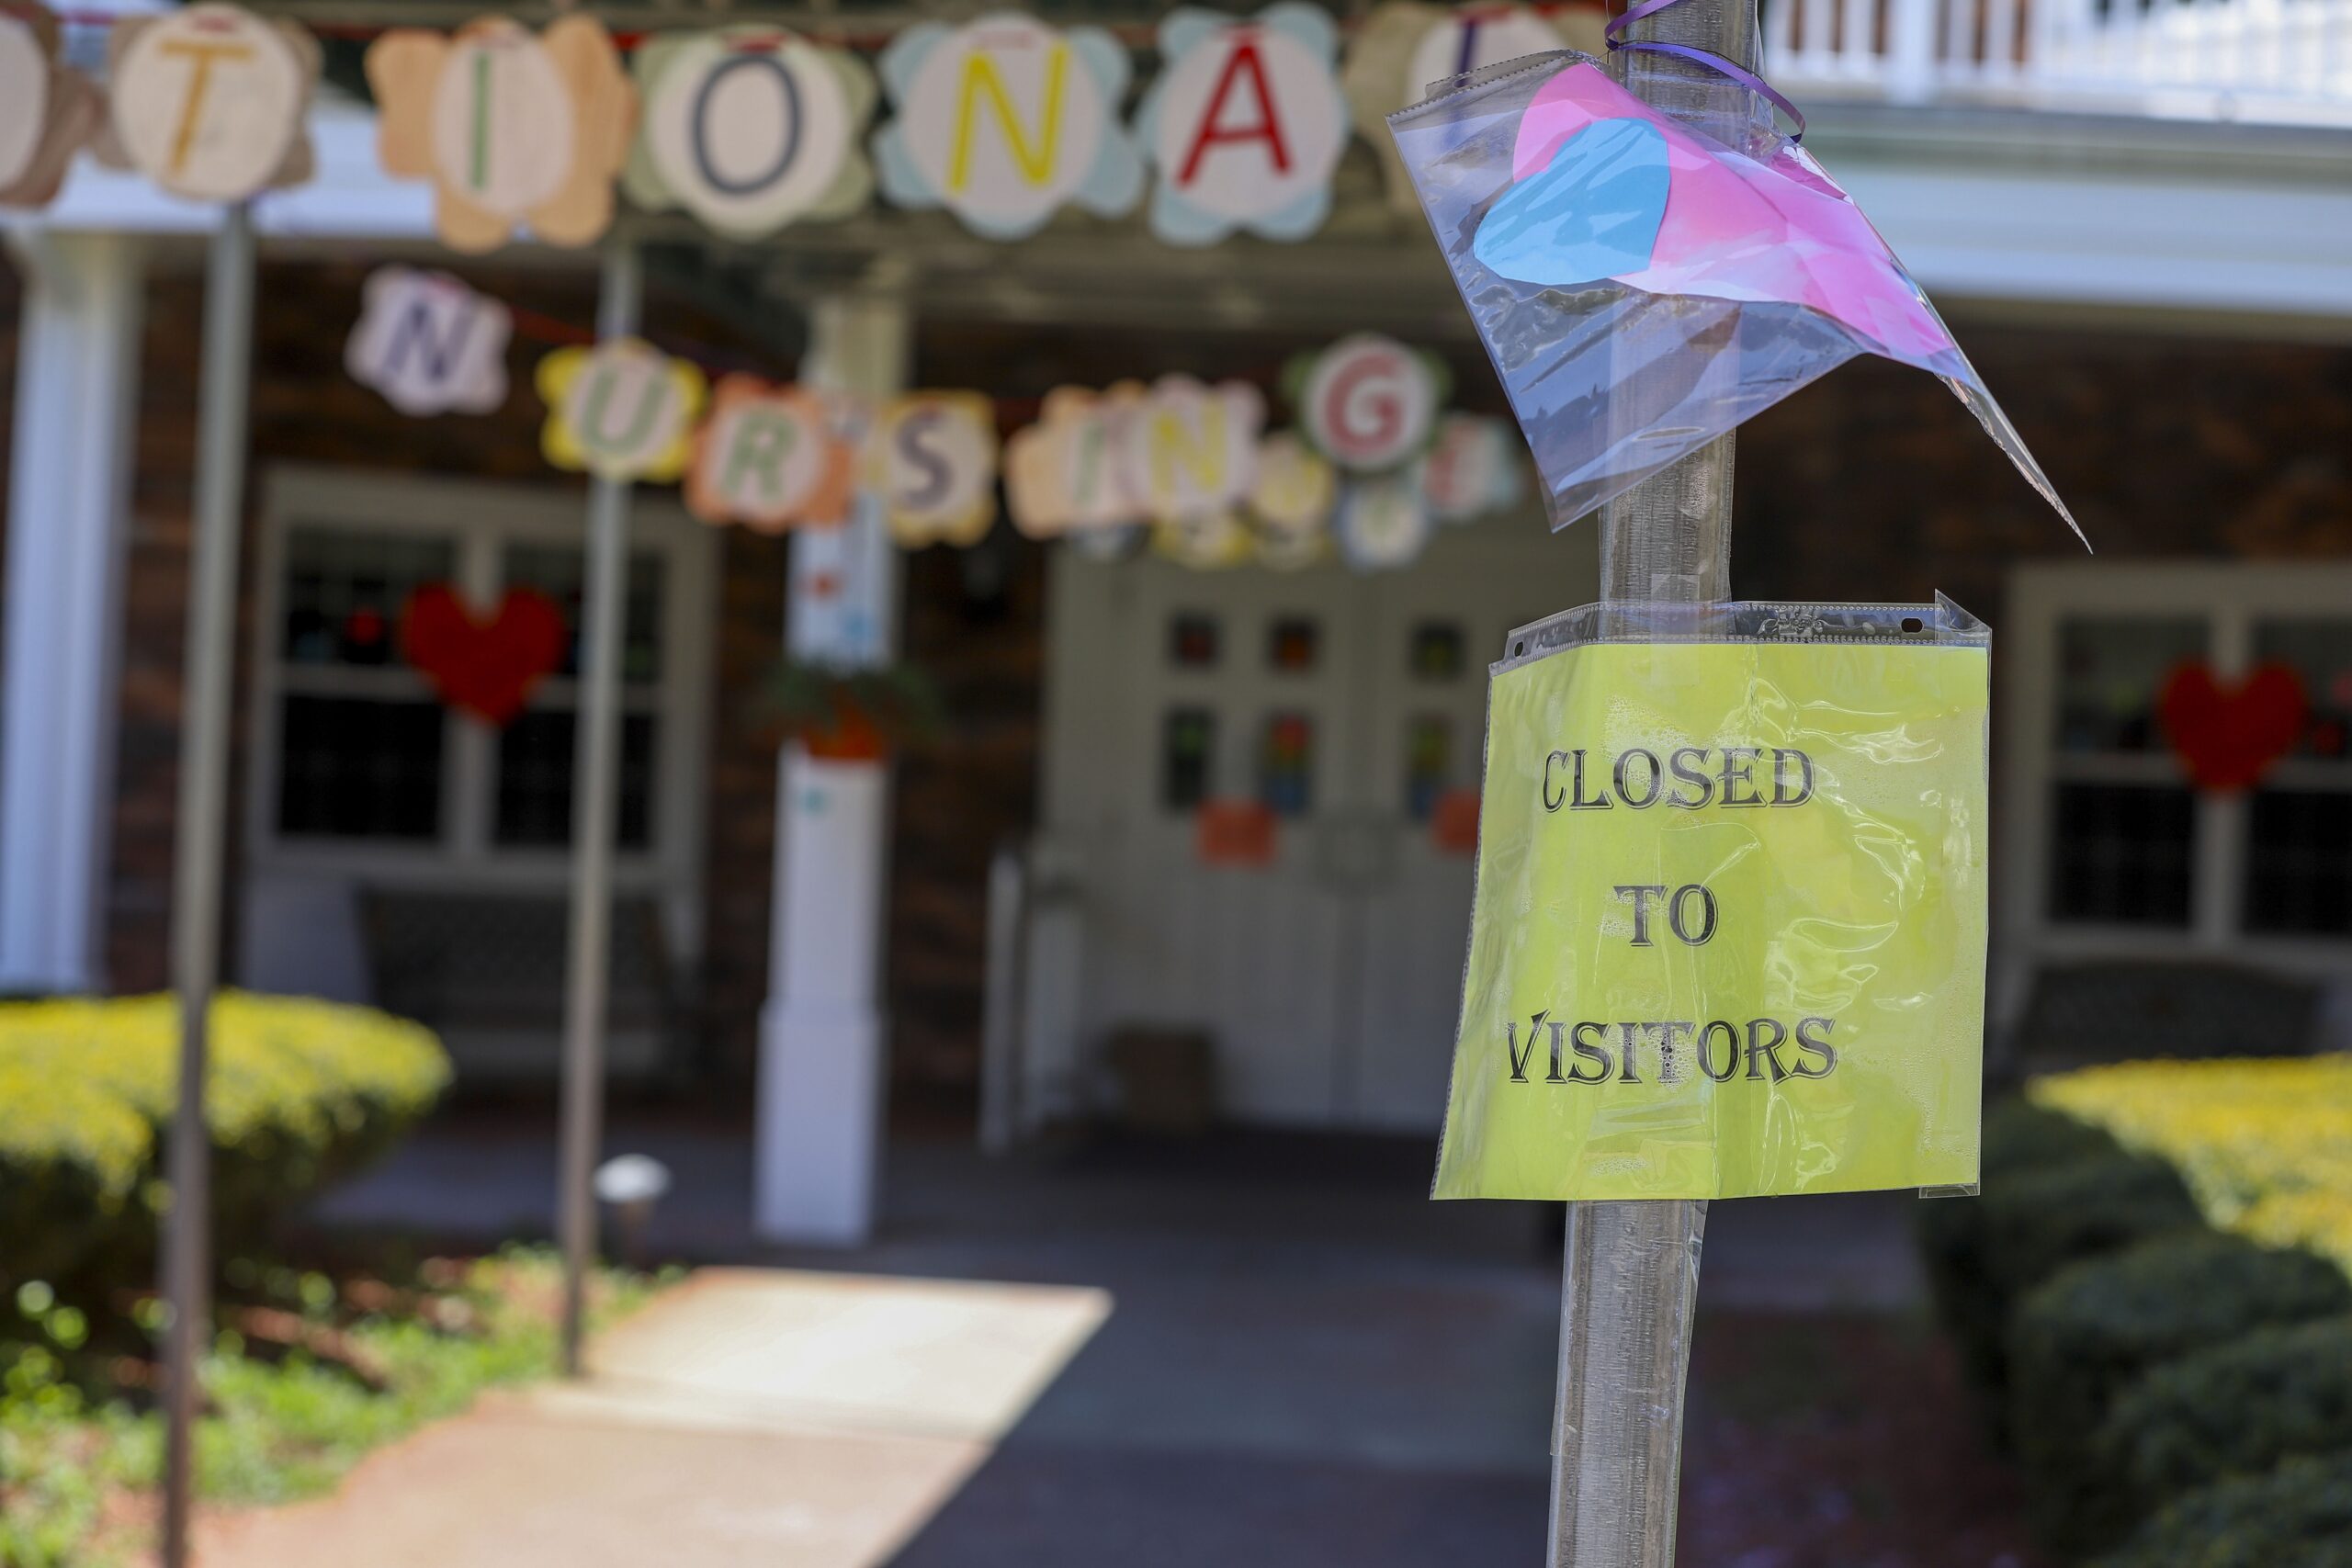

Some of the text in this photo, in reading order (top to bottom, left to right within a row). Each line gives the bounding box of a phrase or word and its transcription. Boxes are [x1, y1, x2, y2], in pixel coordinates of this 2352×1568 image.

[381, 299, 1408, 509] NURSING
[1544, 748, 1815, 812] CLOSED
[1613, 884, 1719, 947] TO
[1506, 1009, 1838, 1085] VISITORS
